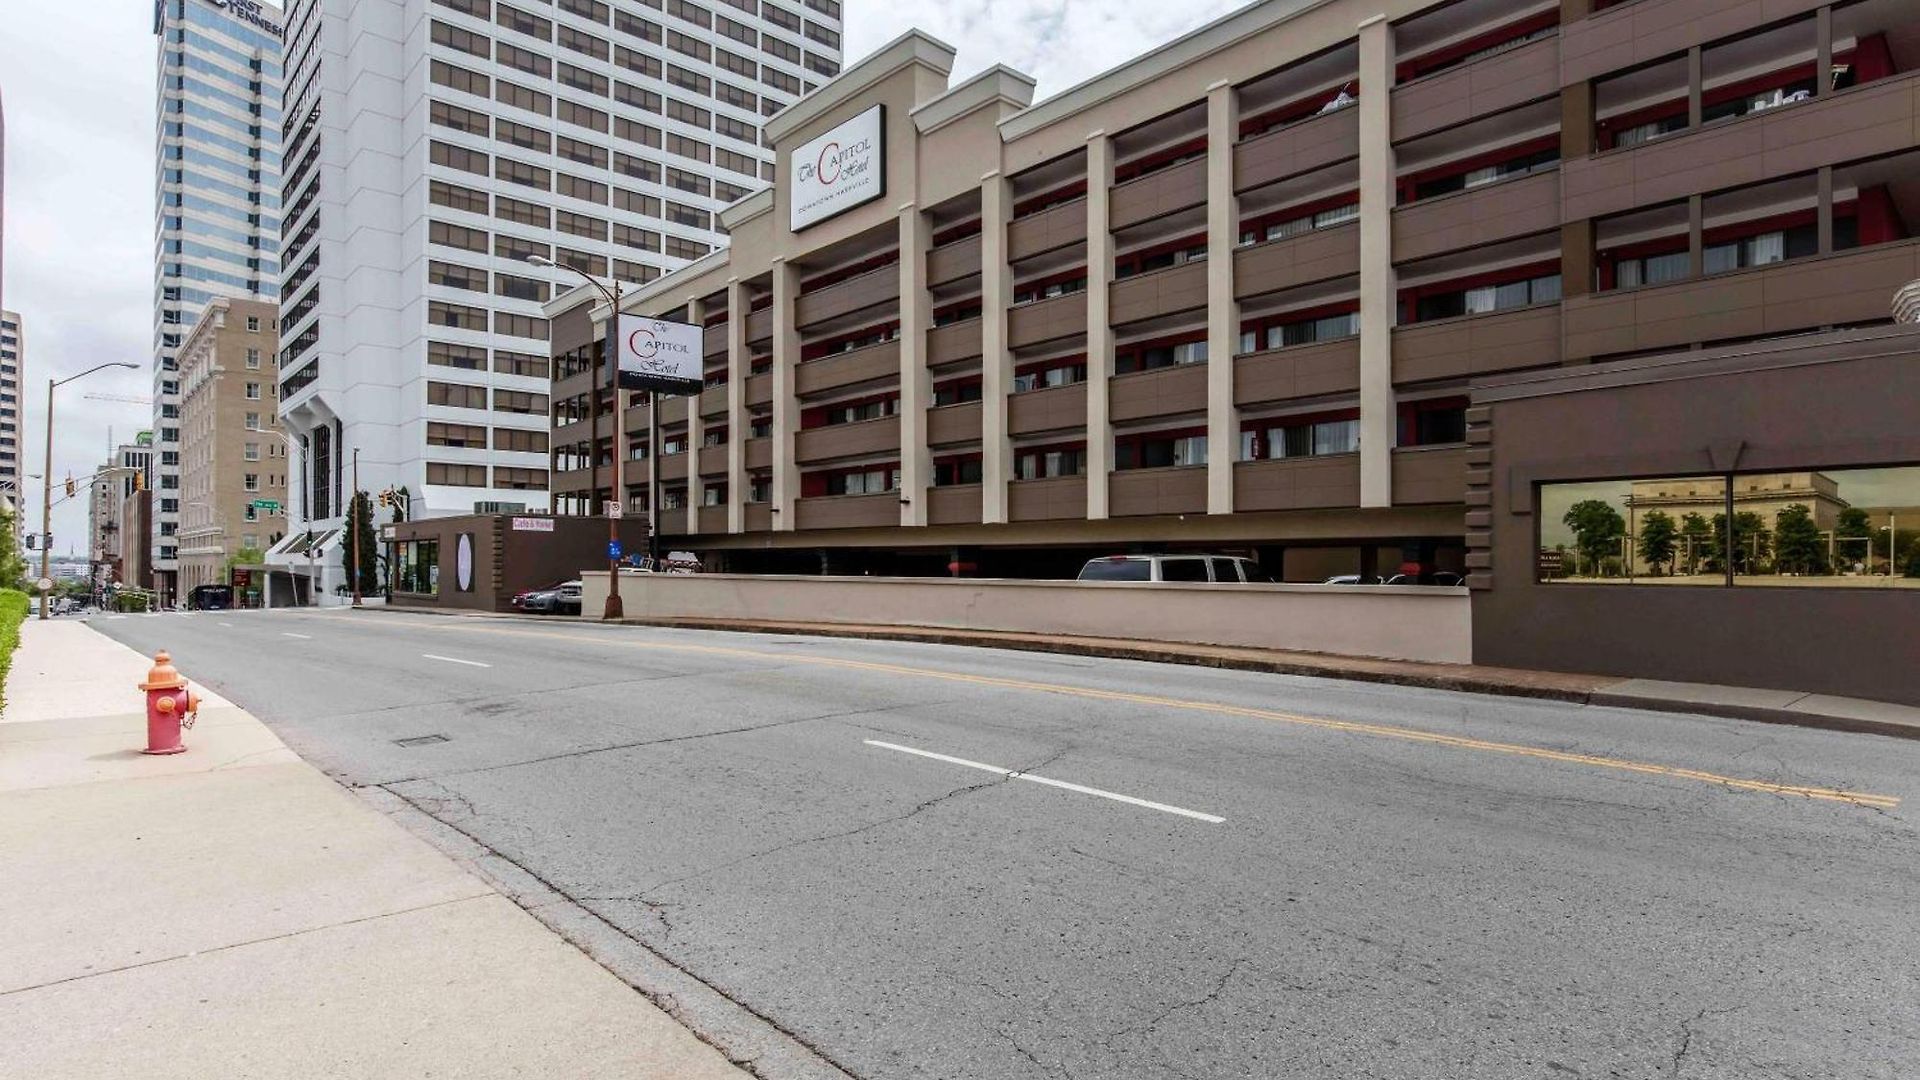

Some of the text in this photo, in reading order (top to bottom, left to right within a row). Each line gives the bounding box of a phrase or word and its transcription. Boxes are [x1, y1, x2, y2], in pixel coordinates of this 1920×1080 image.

[841, 156, 869, 181] Hotel
[630, 329, 689, 359] CAPITOL
[641, 359, 679, 374] Hotel
